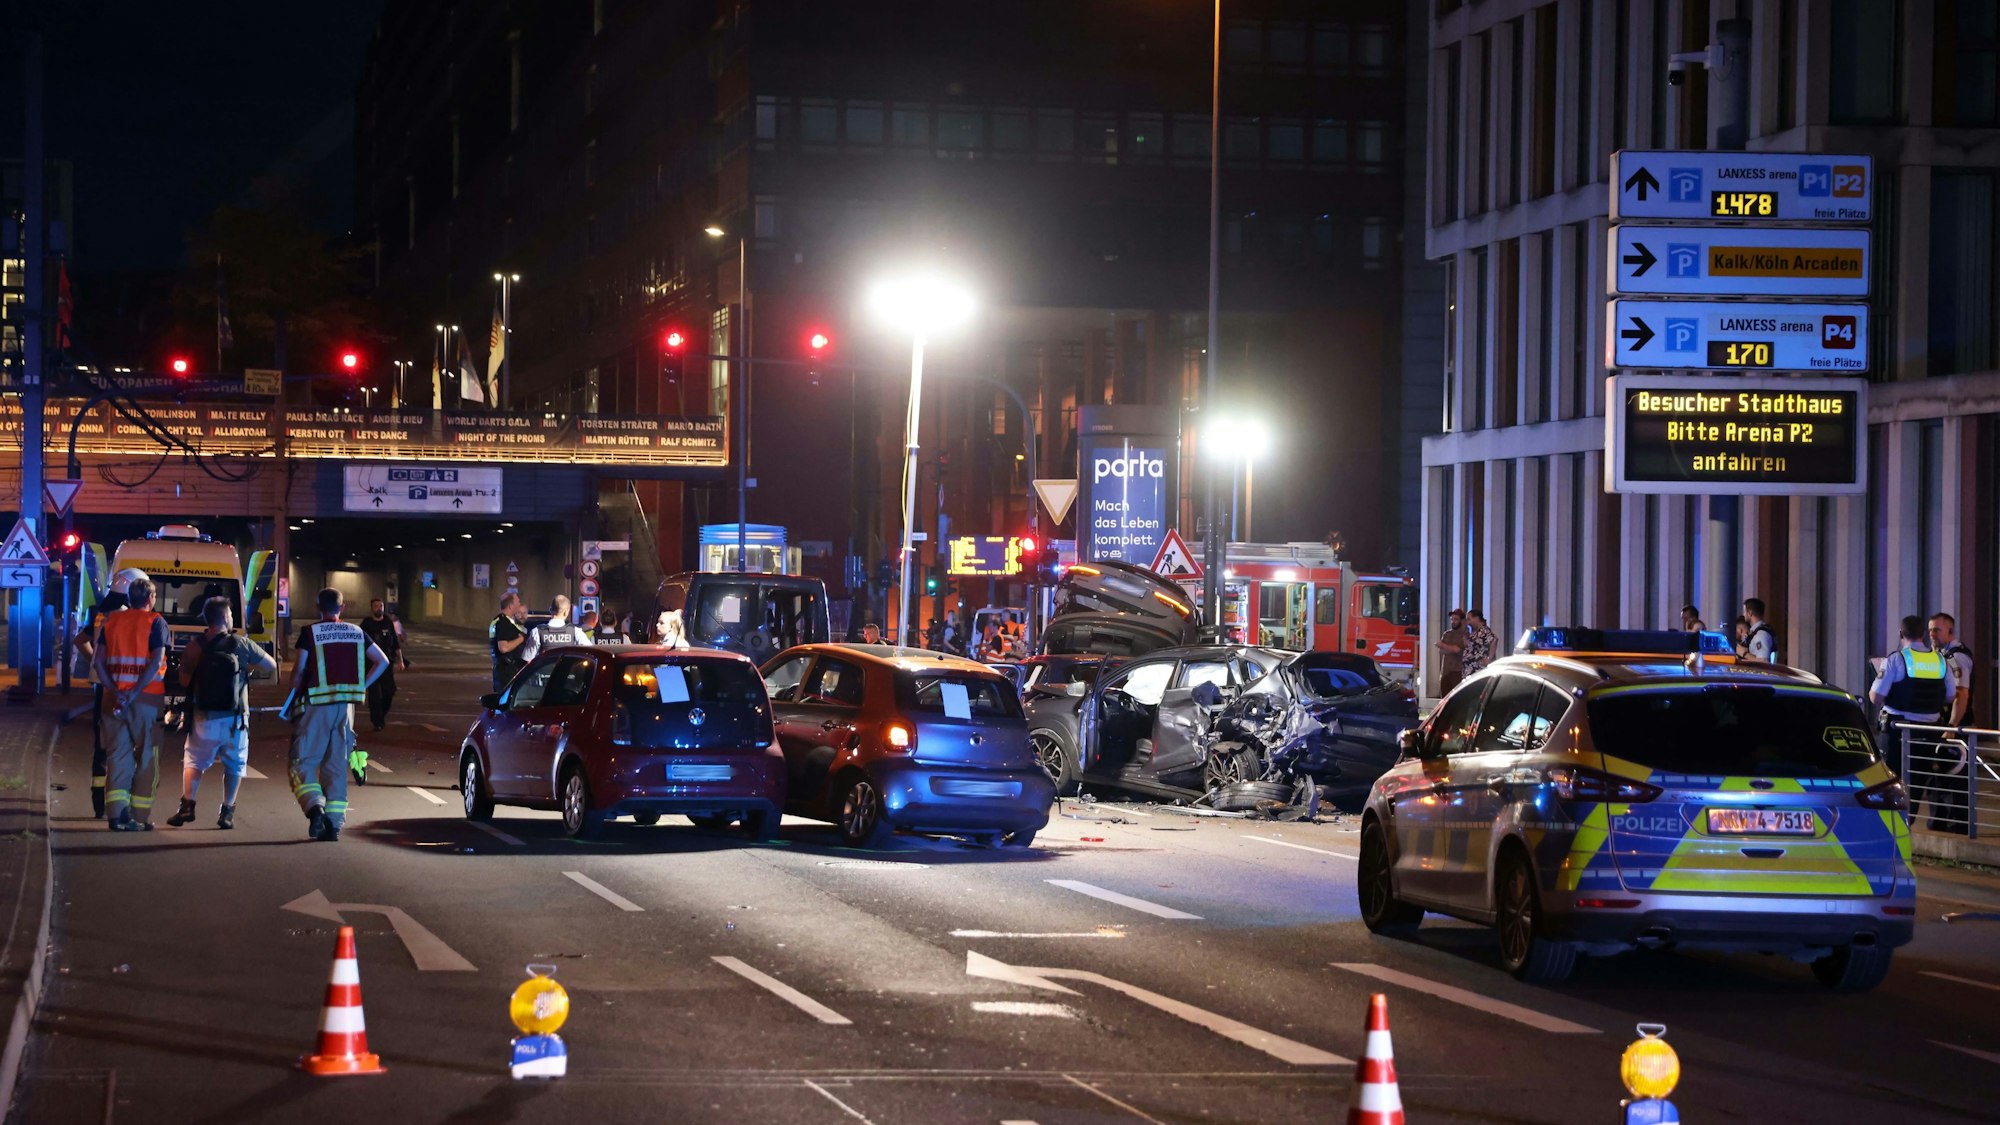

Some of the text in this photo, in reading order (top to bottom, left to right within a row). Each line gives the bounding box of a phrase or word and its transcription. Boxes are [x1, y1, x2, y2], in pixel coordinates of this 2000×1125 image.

[1718, 168, 1797, 180] LANXESS arena
[1802, 173, 1862, 191] P1 P2
[1814, 208, 1866, 219] freie Plätze
[1714, 254, 1858, 272] Kalk/Köln Arcaden
[1720, 318, 1813, 333] LANXESS arena
[1825, 324, 1853, 341] P4
[1726, 344, 1768, 365] 170
[1810, 357, 1862, 368] freie Plätze
[1639, 392, 1842, 414] Besucher Stadthaus
[70, 407, 98, 416] EZEL
[115, 408, 141, 418] LUIS
[239, 411, 266, 421] KELLY
[286, 412, 364, 423] PAULS DRAG RACE
[402, 415, 423, 425] RIEU
[447, 417, 530, 427] WORLD DARTS GALA
[155, 425, 184, 435] NCHT
[582, 420, 619, 429] TORSTEN
[667, 421, 721, 432] MARIO BARTH
[214, 427, 266, 436] ALLIGATOAH
[289, 428, 345, 439] KERSTIN OTT
[356, 430, 408, 440] LET'S DANCE
[1667, 422, 1813, 443] Bitte Arena P2
[459, 432, 545, 443] NIGHT OF THE PROMS
[585, 435, 616, 445] MARTIN
[660, 436, 716, 447] RALF SCHMITZ
[1095, 451, 1164, 484] porta
[1693, 453, 1786, 472] anfahren
[1095, 500, 1129, 512] Mach
[1095, 517, 1159, 529] das Leben
[1095, 534, 1156, 547] komplett.
[140, 567, 221, 576] NFALLAUFNAHME
[543, 634, 572, 642] POLIZEI
[1614, 816, 1683, 833] POLIZEI
